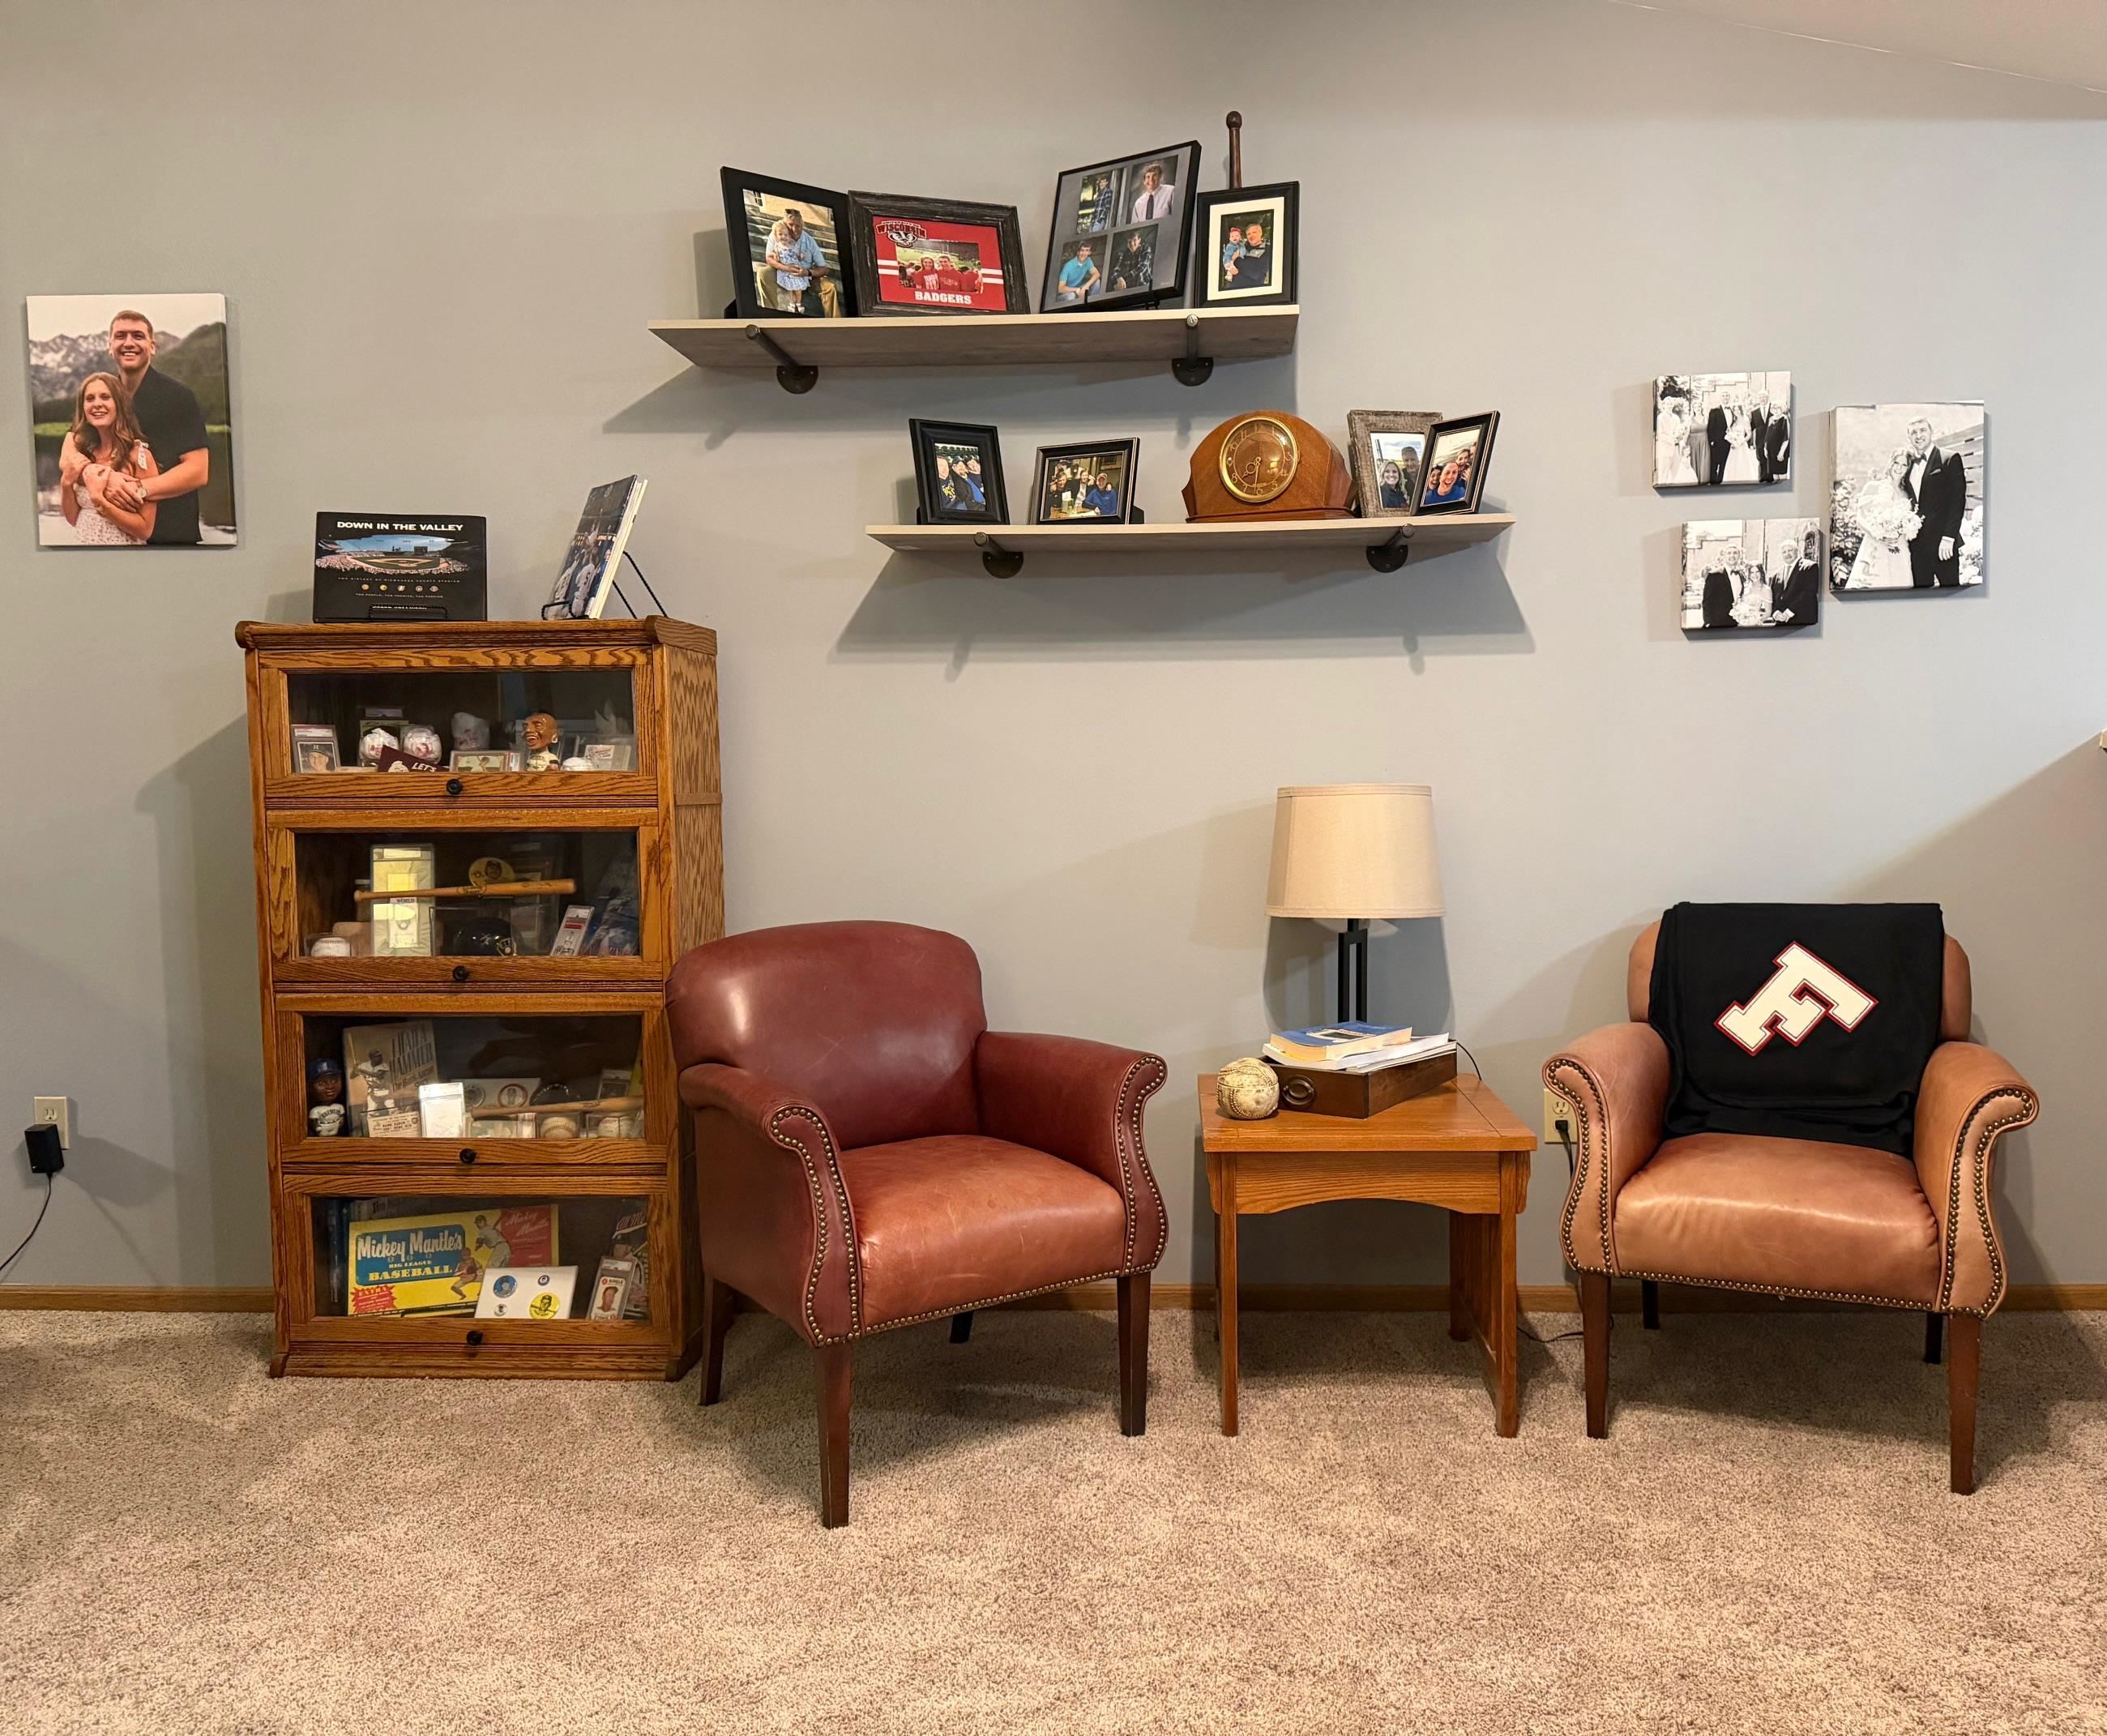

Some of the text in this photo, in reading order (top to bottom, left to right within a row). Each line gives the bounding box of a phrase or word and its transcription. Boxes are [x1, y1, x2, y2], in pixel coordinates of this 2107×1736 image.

[876, 224, 926, 238] WISCONSIN
[915, 291, 972, 305] BADGERS
[337, 521, 373, 529] DOWN
[1714, 940, 1879, 1056] F
[357, 1229, 463, 1262] Mickey Mantle's
[369, 1265, 452, 1281] BASEBALL
